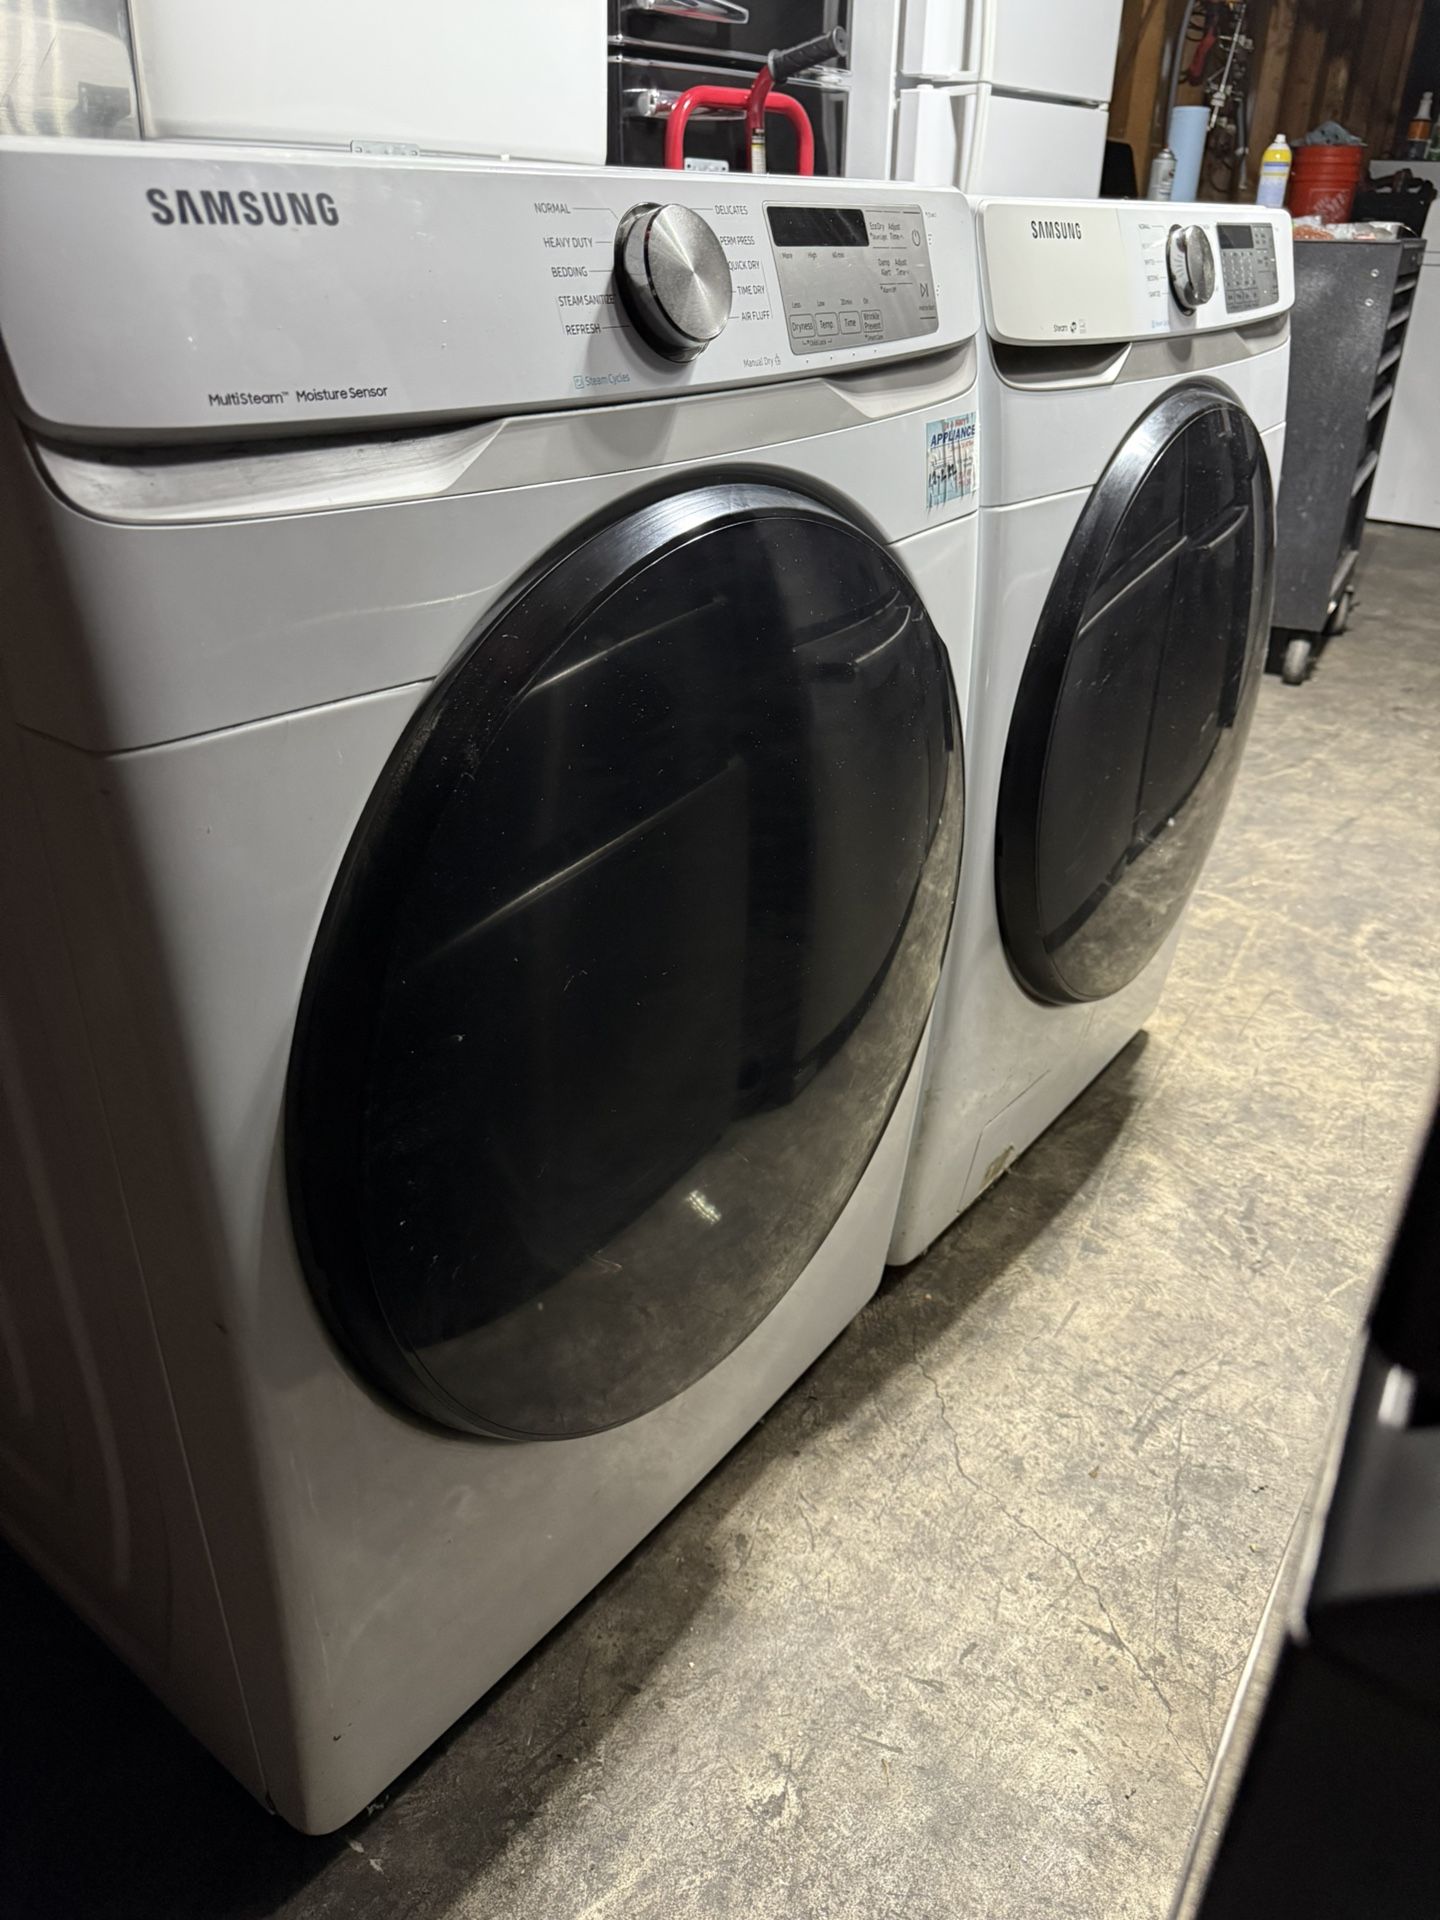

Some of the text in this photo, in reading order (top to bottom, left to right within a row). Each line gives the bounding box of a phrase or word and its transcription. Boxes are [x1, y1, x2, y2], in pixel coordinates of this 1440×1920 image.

[145, 188, 339, 226] SAMSUNG
[534, 202, 571, 214] NORMAL
[714, 204, 749, 215] DELICATES
[1031, 220, 1082, 240] SAMSUNG
[543, 237, 593, 248] HEAVY DUTY
[720, 235, 755, 246] PERM PRESS
[728, 260, 760, 271] QUICK DRY
[551, 266, 588, 278] BEDDING
[737, 285, 765, 296] TIME DRY
[558, 294, 615, 307] STEAM SANITIZE
[741, 310, 771, 321] AIR FLUFF
[565, 322, 602, 335] REFRESH
[792, 321, 814, 333] Dryness
[743, 356, 774, 368] Manual Dry
[585, 376, 607, 386] Steam
[296, 389, 348, 403] Moisture
[349, 386, 388, 400] Sensor
[931, 425, 975, 447] APPLIANCE
